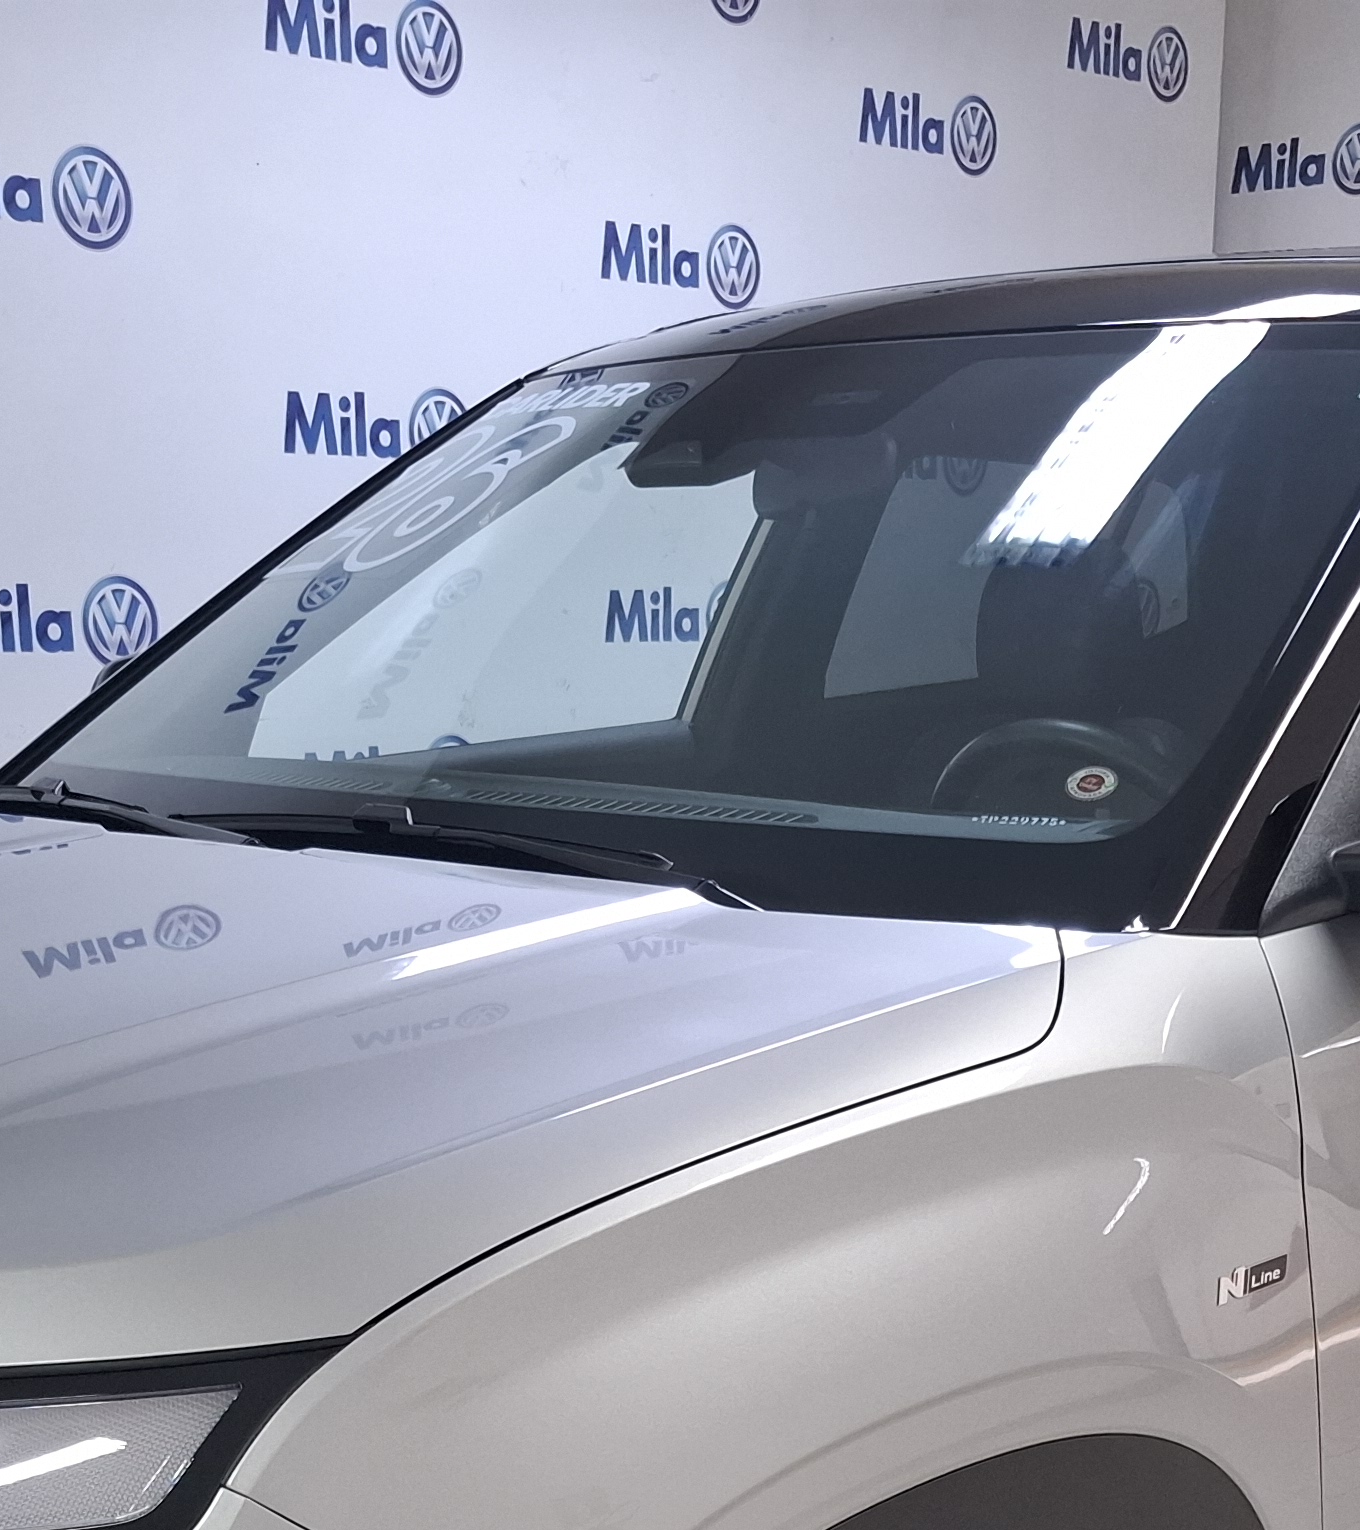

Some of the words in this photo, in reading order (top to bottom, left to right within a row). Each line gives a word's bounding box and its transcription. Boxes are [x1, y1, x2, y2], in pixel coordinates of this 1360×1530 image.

[266, 0, 387, 68] Mila
[1067, 17, 1142, 81] Mila
[860, 88, 944, 154] Mila
[1231, 137, 1325, 194] Mila
[601, 221, 699, 288] Mila
[284, 391, 401, 457] Mila
[606, 587, 699, 642] Mila
[1251, 1268, 1281, 1288] Line
